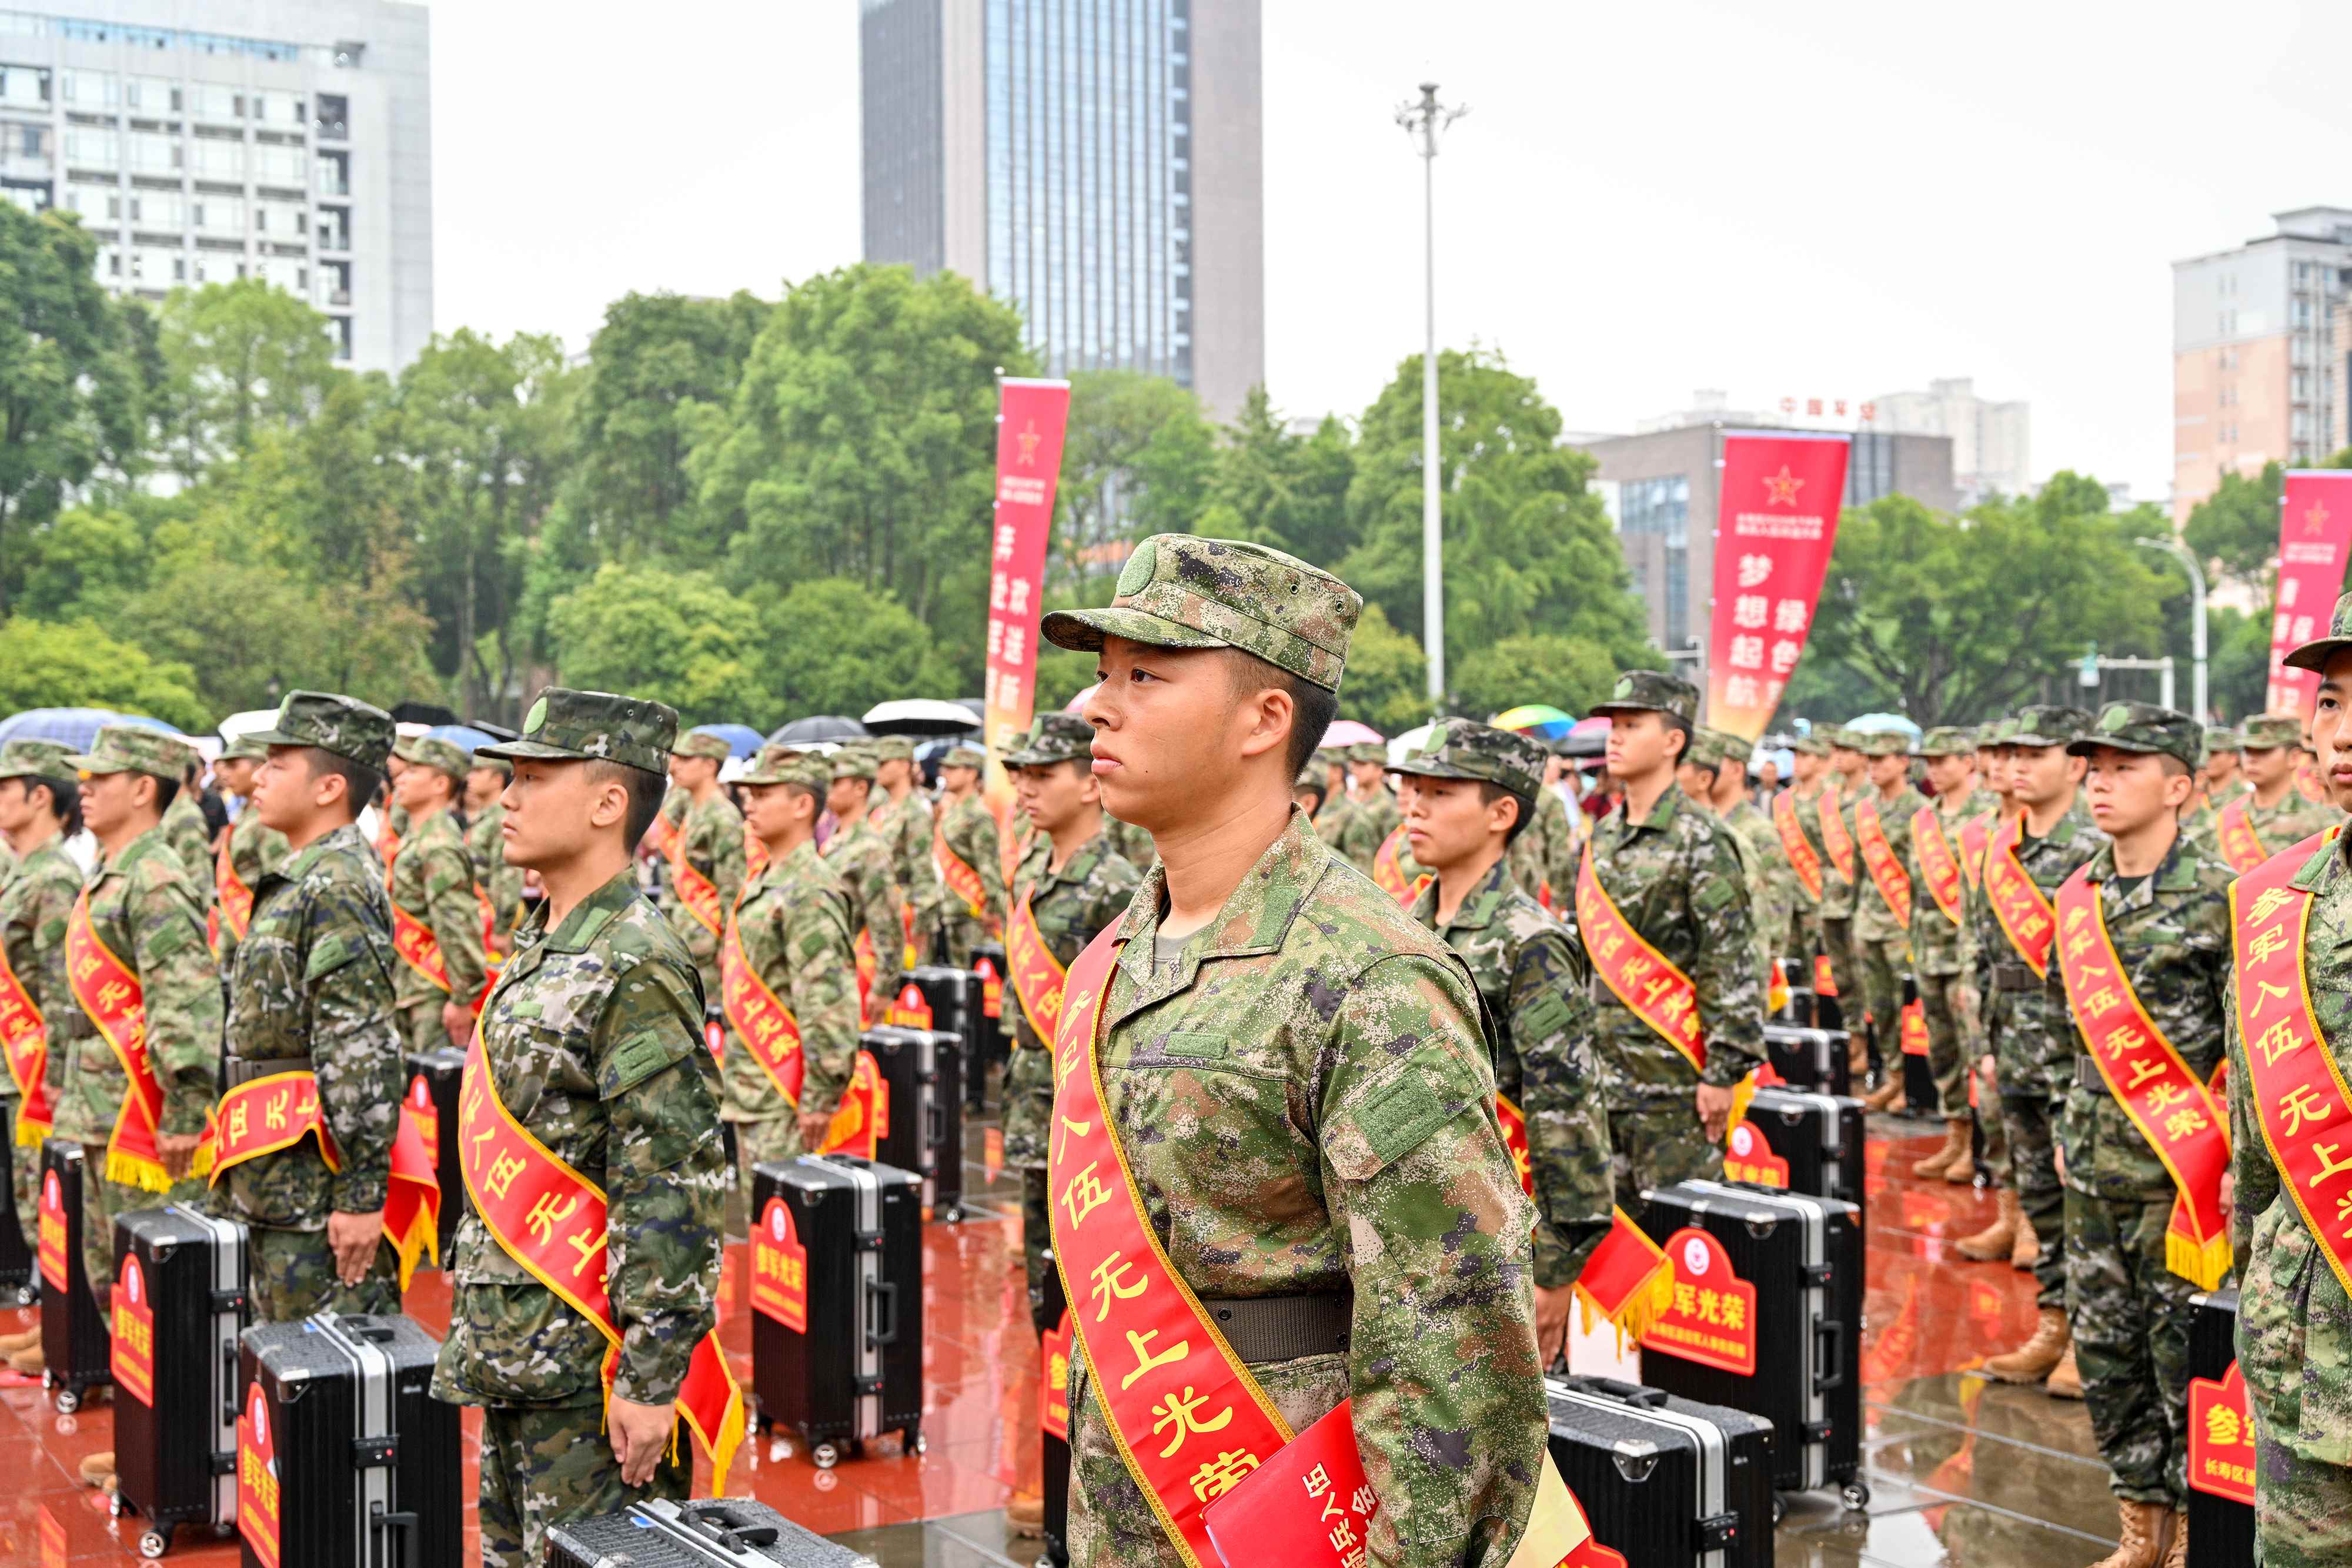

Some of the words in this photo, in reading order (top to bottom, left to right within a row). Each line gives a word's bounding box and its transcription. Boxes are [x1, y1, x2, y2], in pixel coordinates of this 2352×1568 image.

[1725, 553, 1773, 707] 梦想起航
[731, 975, 800, 1064] 无上光荣
[2064, 905, 2121, 1019] 参军入伍
[2104, 1024, 2209, 1142] 无上光荣
[2245, 887, 2303, 1068] 参军入伍
[1054, 989, 1112, 1231] 参军入伍
[525, 1192, 610, 1296] 无上
